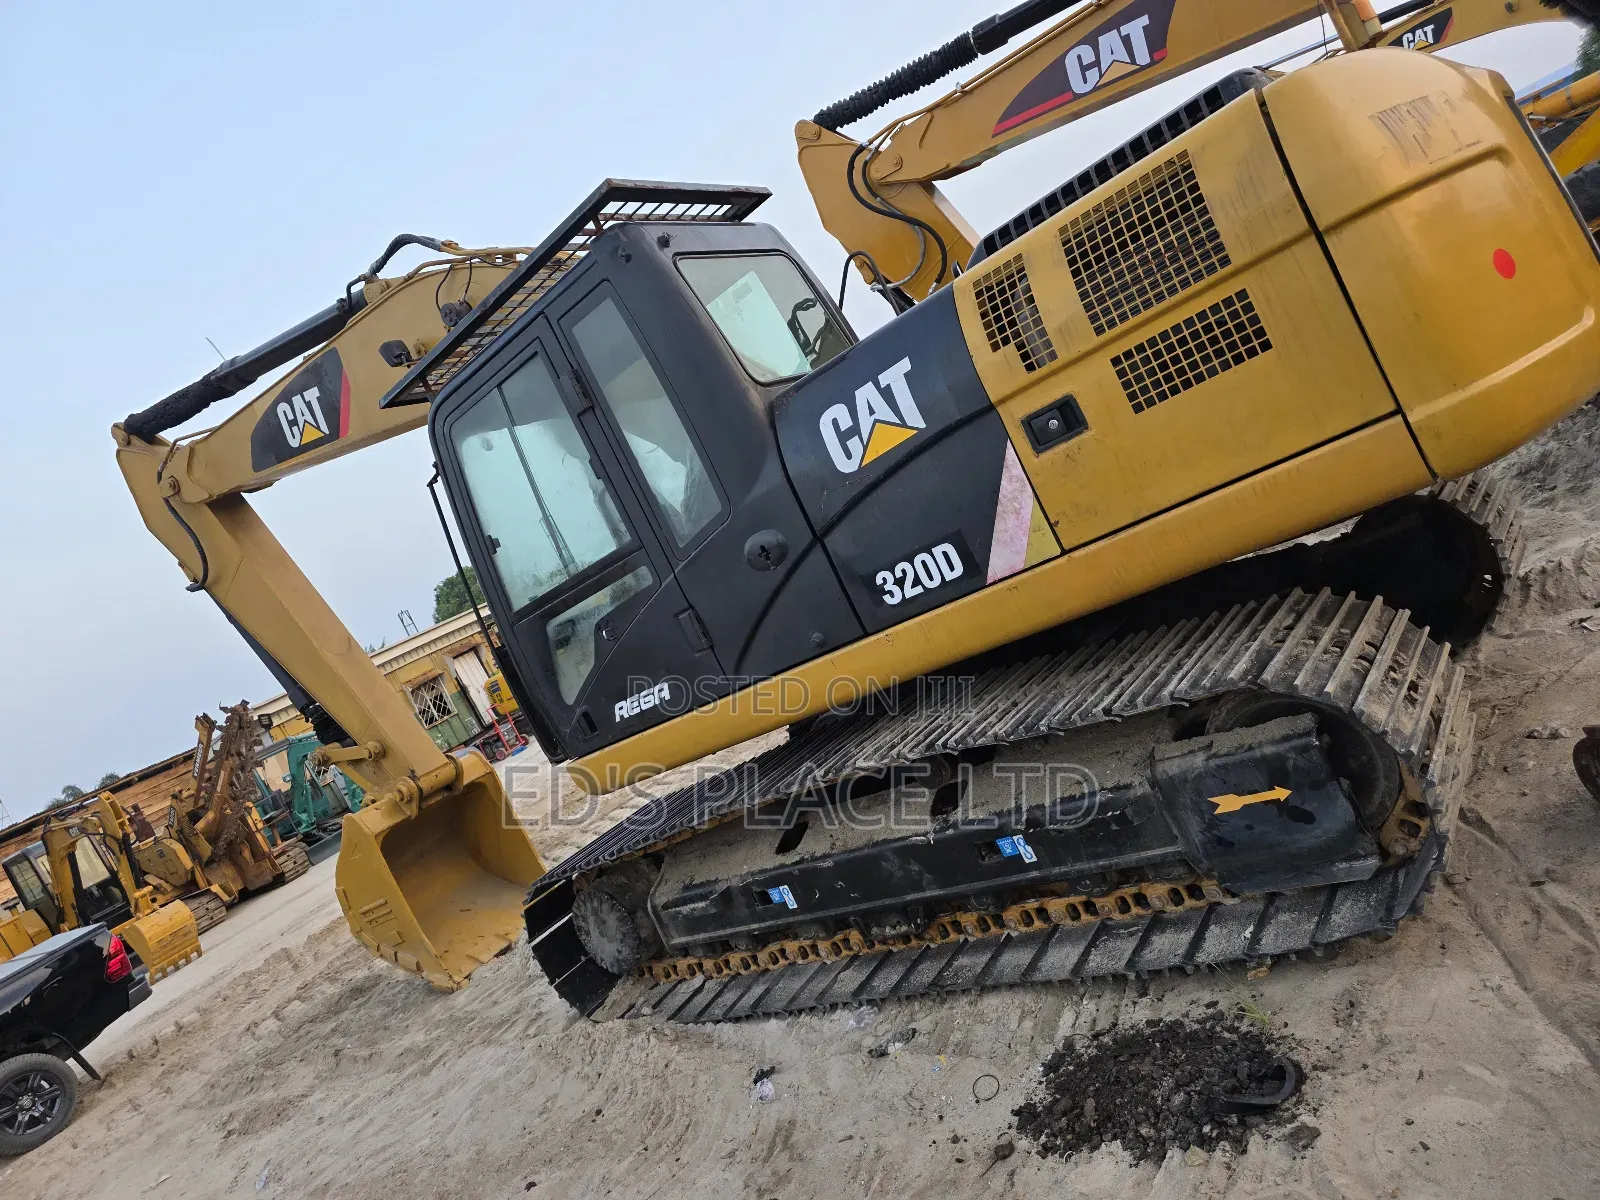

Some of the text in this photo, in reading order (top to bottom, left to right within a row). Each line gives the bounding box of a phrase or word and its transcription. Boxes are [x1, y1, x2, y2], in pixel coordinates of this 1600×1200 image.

[1064, 14, 1152, 95] CAT
[1402, 23, 1435, 50] CAT
[276, 385, 330, 448] CAT
[819, 356, 927, 474] CAT
[875, 542, 964, 606] 320D
[614, 682, 671, 723] REGA
